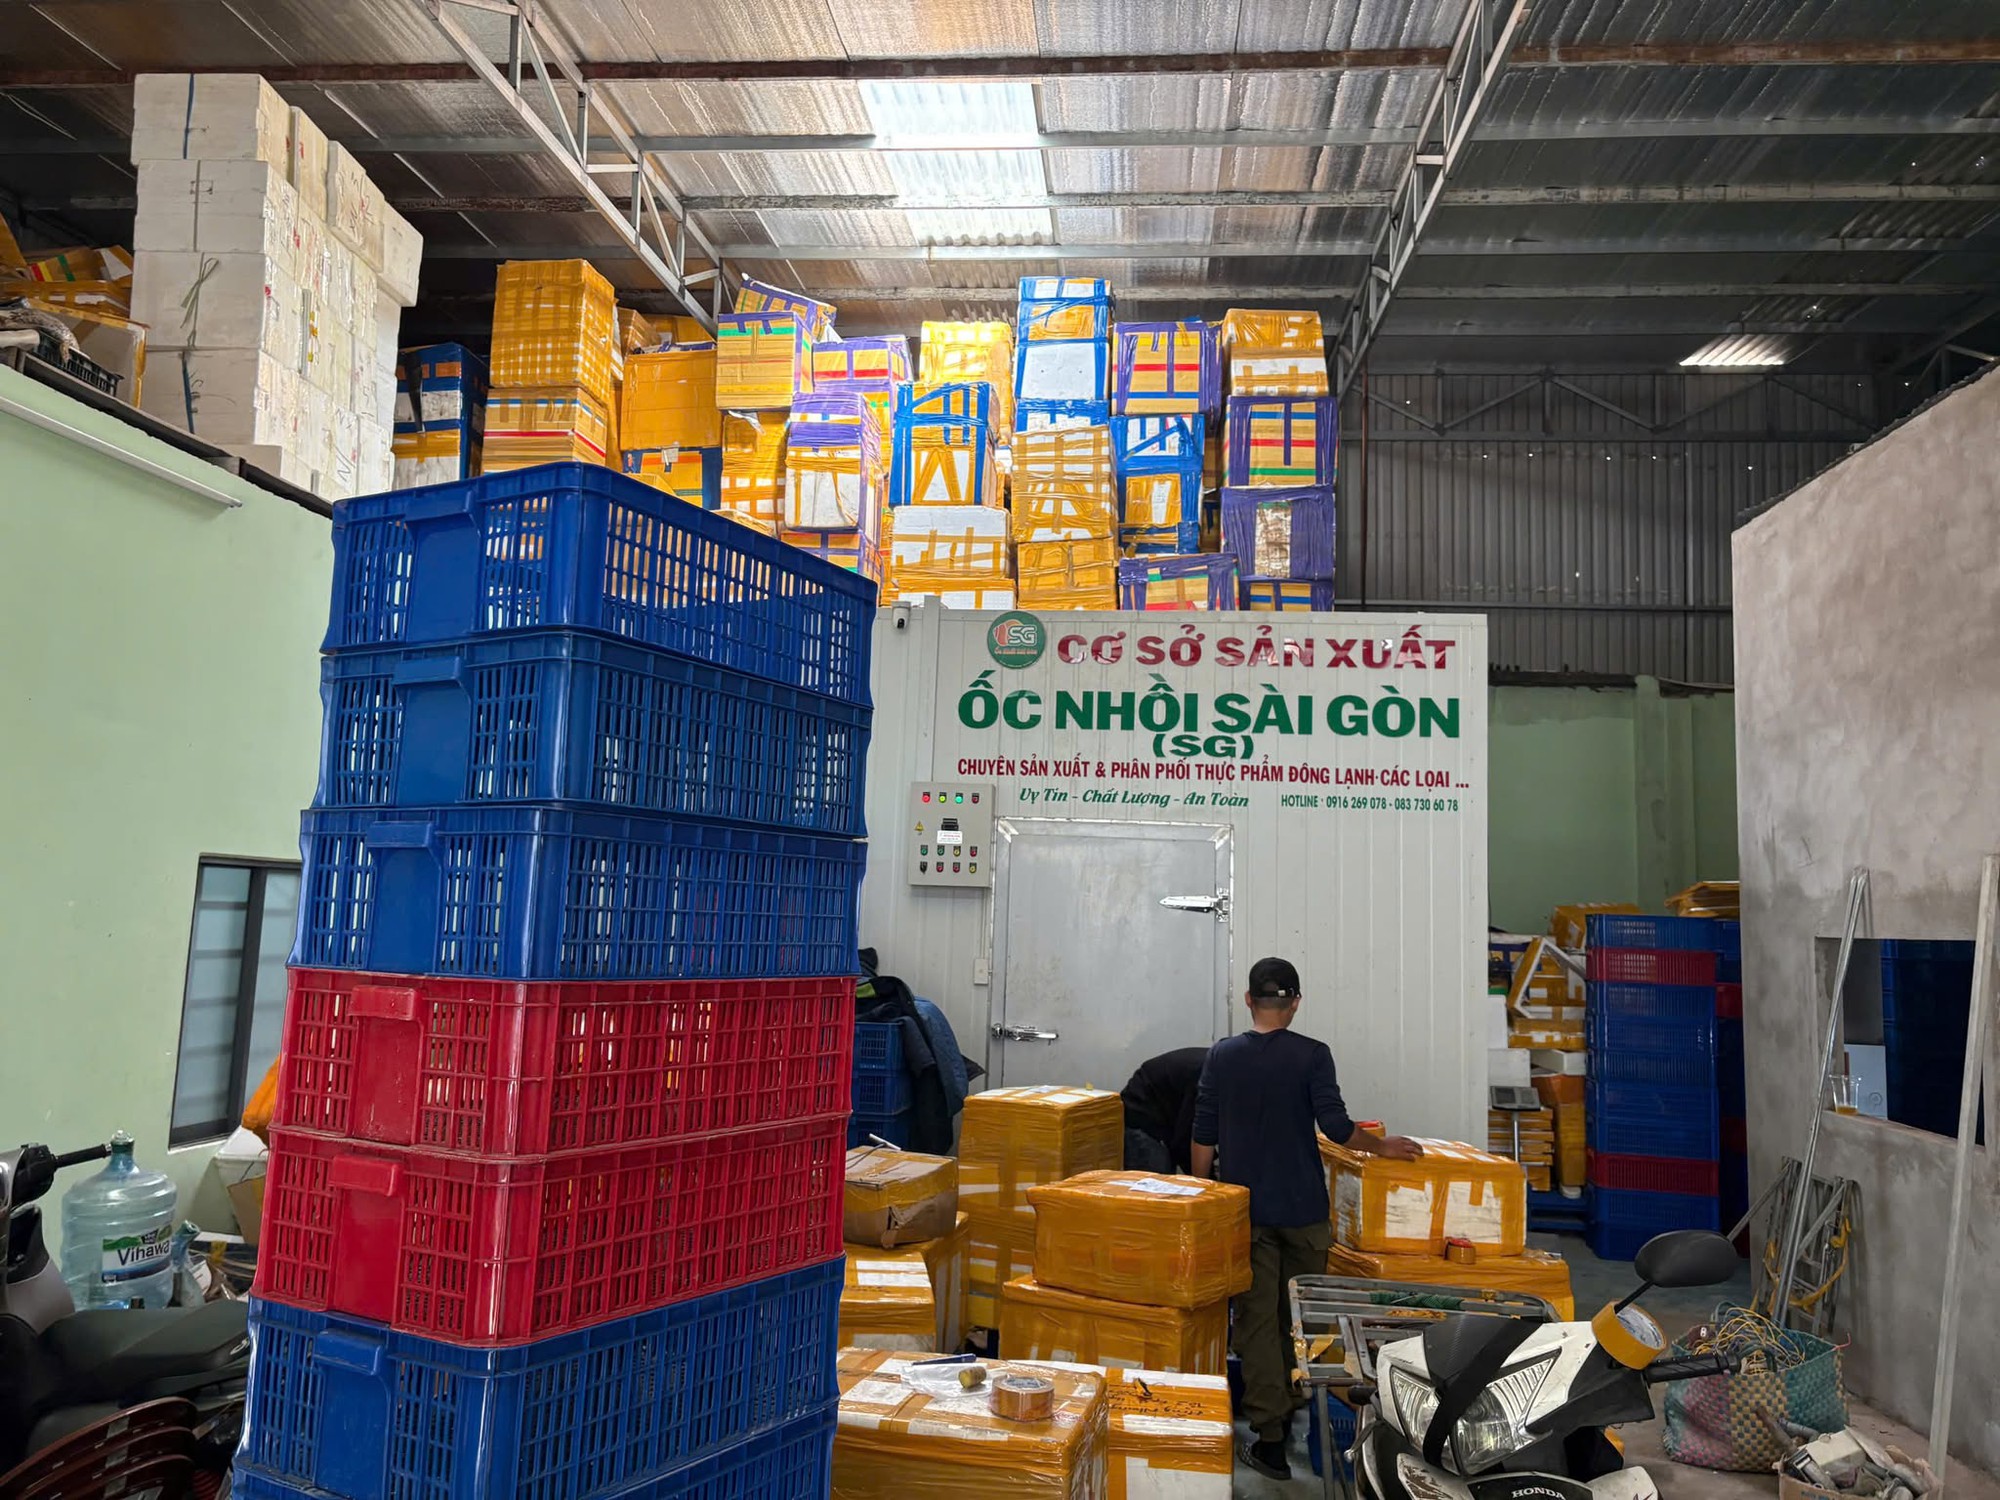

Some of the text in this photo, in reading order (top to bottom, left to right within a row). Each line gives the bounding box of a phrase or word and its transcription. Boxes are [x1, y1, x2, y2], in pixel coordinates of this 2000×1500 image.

[1008, 625, 1036, 645] SG
[1057, 624, 1456, 669] CƠ SỞ SẢN XUẤT
[958, 670, 1460, 738] ỐC NHỒI SÀI GÒN
[1152, 734, 1254, 760] (SG)
[958, 755, 1016, 777] CHUYÊN
[1020, 754, 1049, 777] SẢN
[1053, 753, 1090, 778] XUẤT
[1095, 760, 1107, 779] &
[1111, 758, 1150, 780] PHÂN
[1155, 756, 1191, 781] PHỐI
[1195, 762, 1235, 785] THỰC
[1241, 755, 1284, 783] PHẨM
[1288, 763, 1330, 785] ĐÔNG
[1082, 788, 1119, 804] Chất
[1121, 790, 1171, 808] Lượng
[1183, 791, 1206, 806] An
[1211, 792, 1249, 807] Toàn
[1326, 796, 1349, 809] 0916
[1350, 796, 1368, 809] 269
[1369, 797, 1387, 810] 078
[1394, 797, 1412, 810] 083
[1413, 798, 1431, 811] 730
[1433, 799, 1445, 811] 60
[1447, 799, 1459, 812] 78
[117, 1240, 170, 1266] Vihawa
[1512, 1487, 1566, 1500] HONDA
